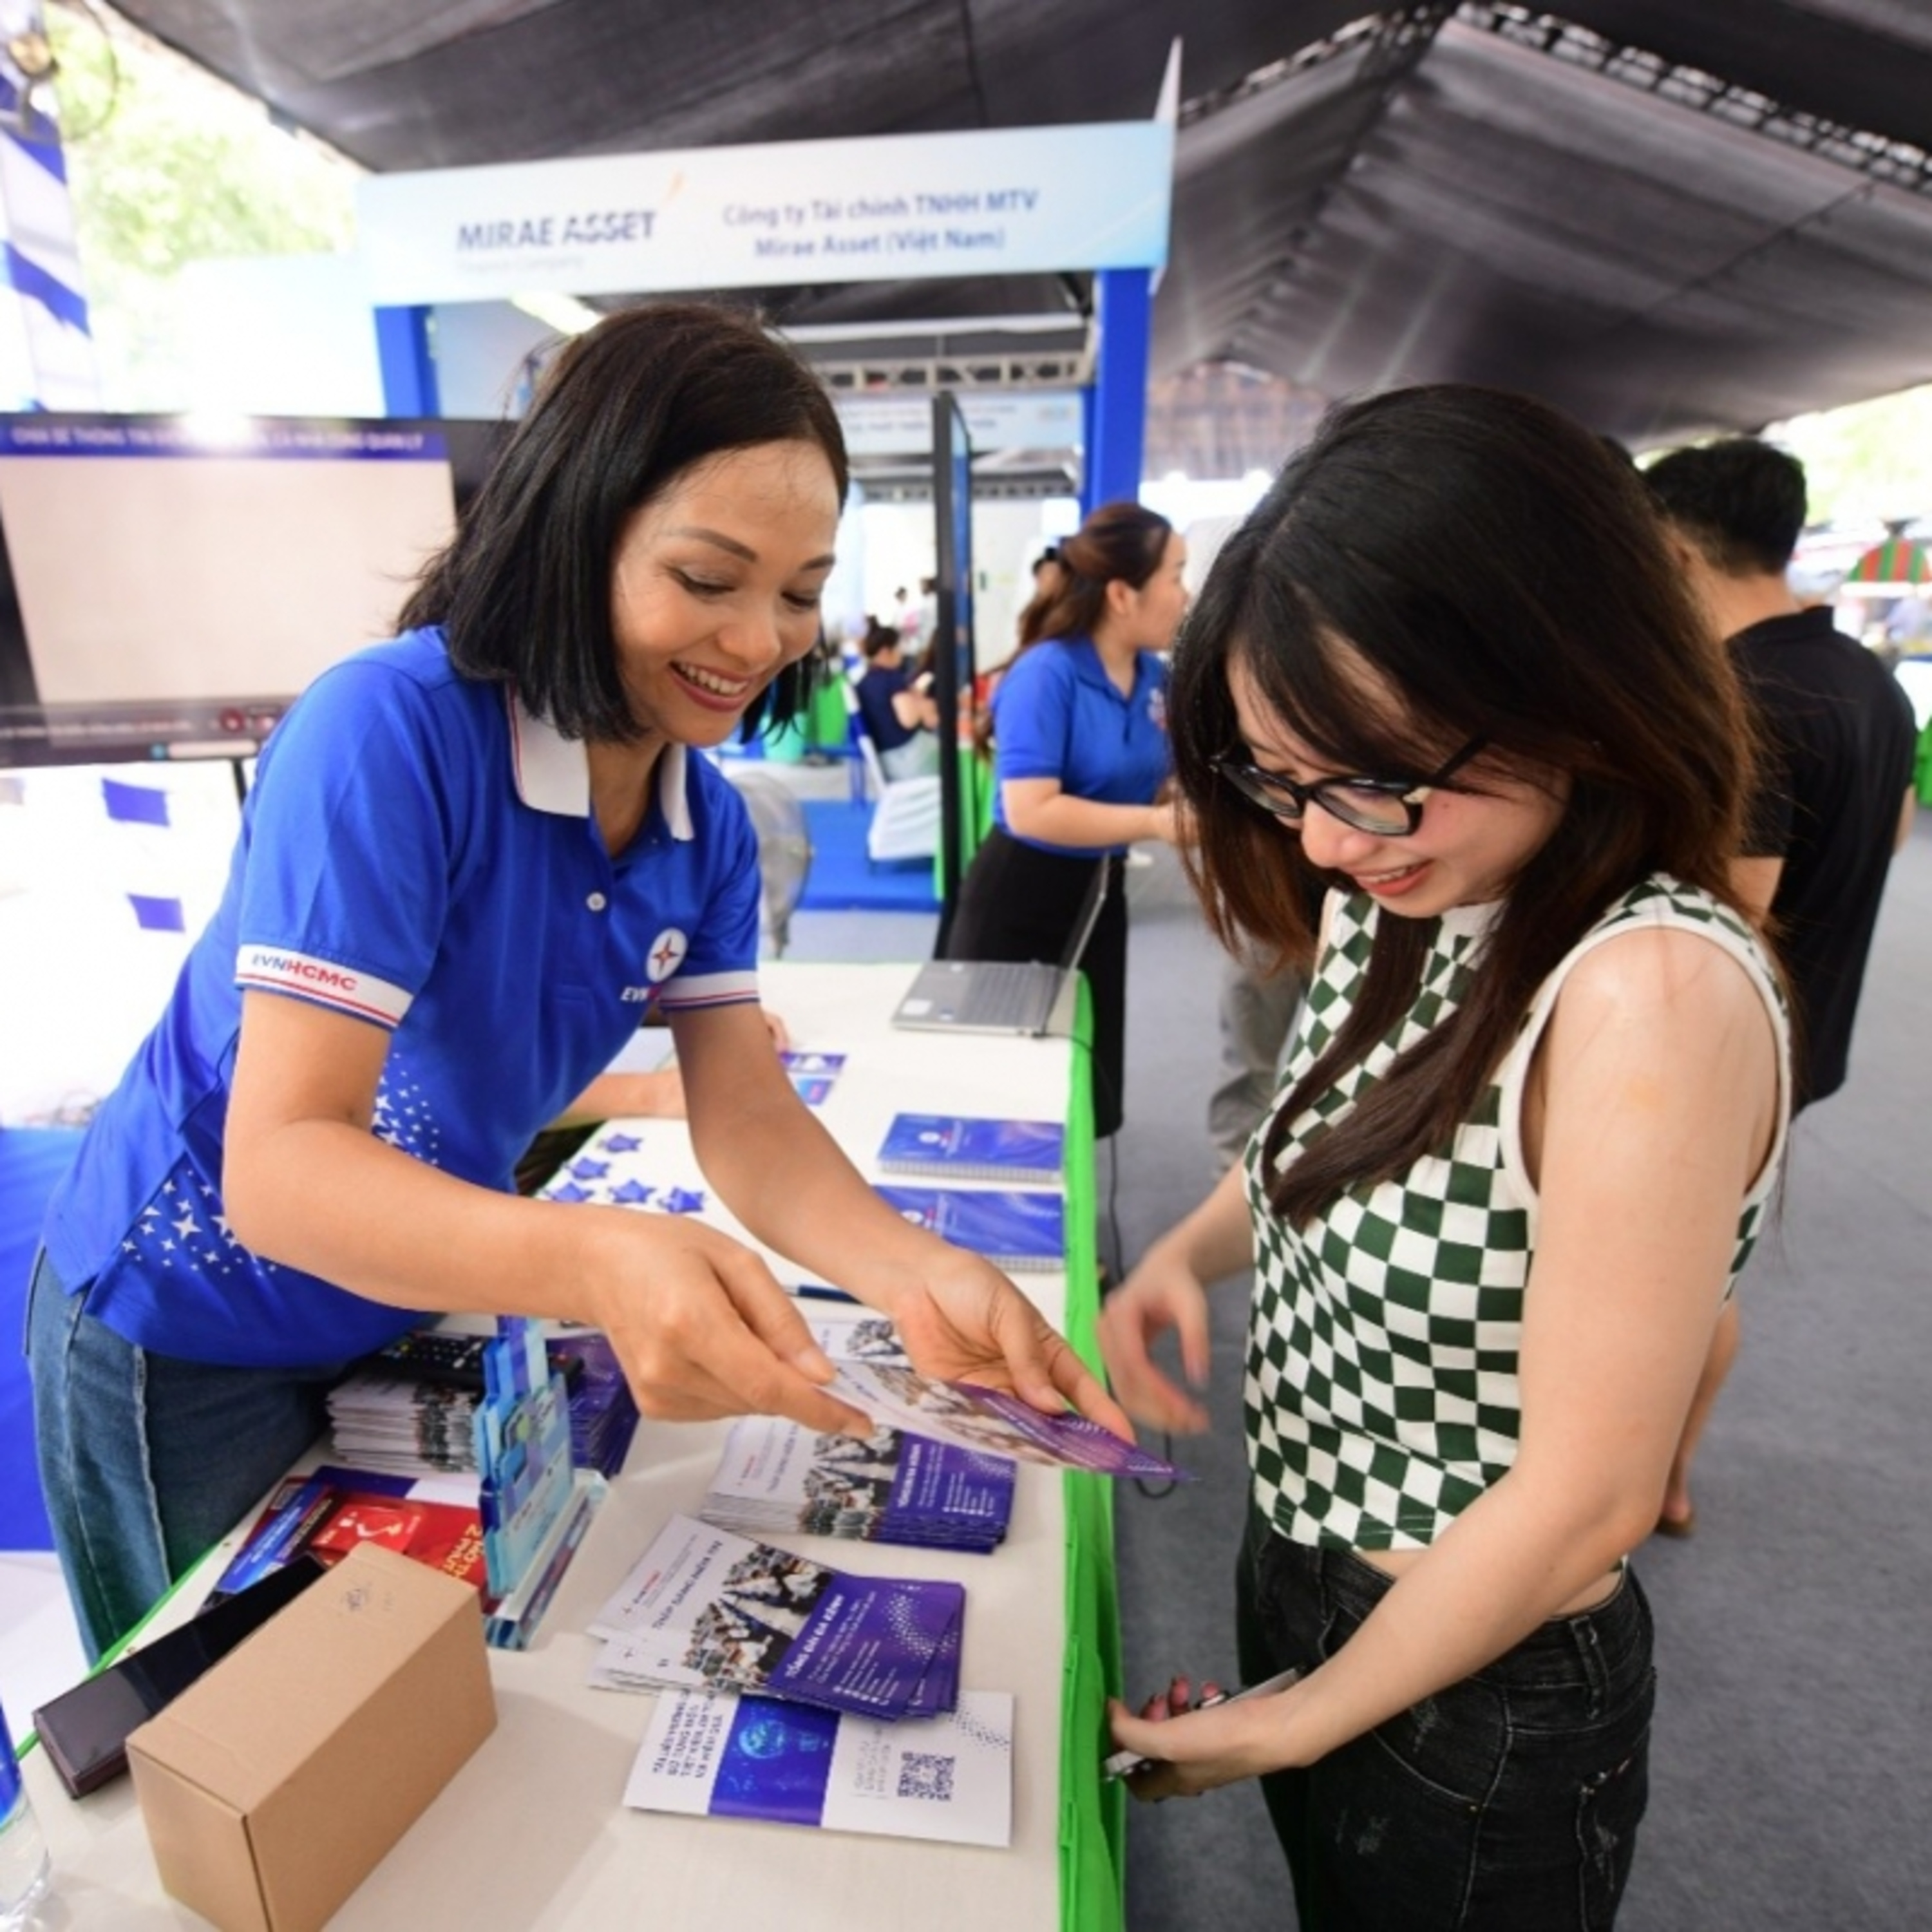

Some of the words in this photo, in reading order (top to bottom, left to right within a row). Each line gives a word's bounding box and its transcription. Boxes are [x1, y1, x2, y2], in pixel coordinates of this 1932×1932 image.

[915, 193, 980, 214] TNHH
[986, 187, 1039, 213] MTV
[457, 217, 554, 251] MIRAE
[561, 210, 656, 246] ASSET
[755, 237, 815, 256] Mirae
[822, 234, 880, 254] Asset
